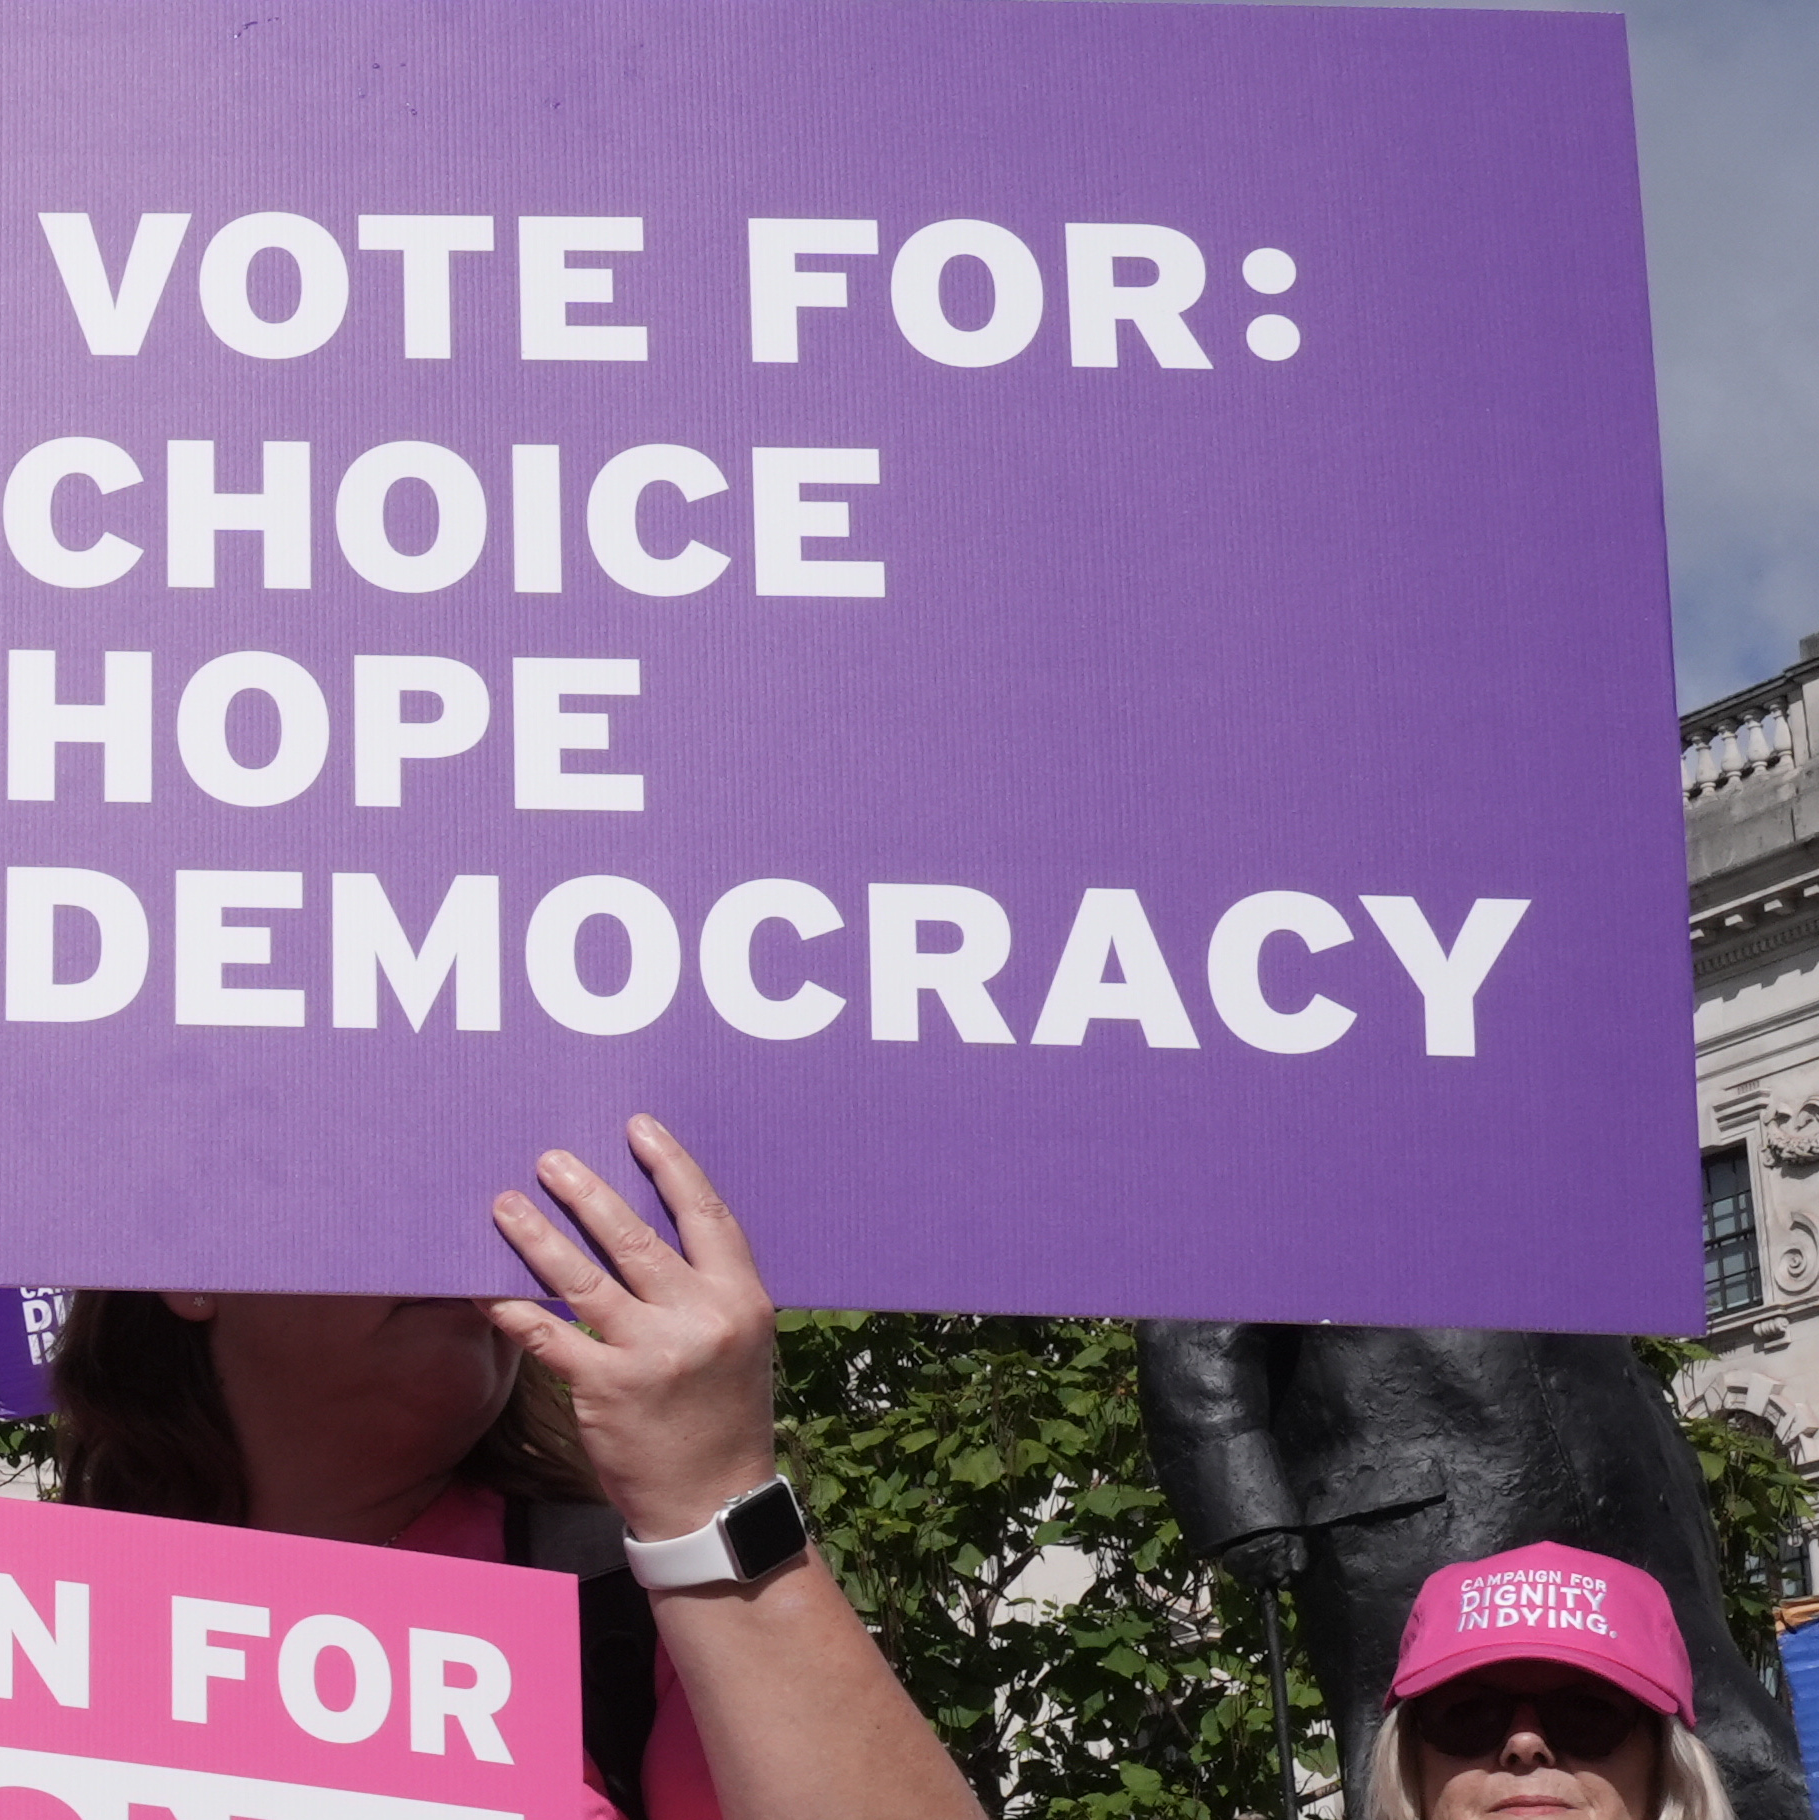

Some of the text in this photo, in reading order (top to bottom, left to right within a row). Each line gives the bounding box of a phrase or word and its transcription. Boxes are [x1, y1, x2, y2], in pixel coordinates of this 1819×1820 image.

[39, 212, 1301, 370] VOTE FOR:
[1, 436, 886, 598] CHOICE
[7, 648, 645, 811] HOPE
[5, 865, 1532, 1057] DEMOCRACY
[1457, 1607, 1618, 1639] IN DYING.
[1460, 1584, 1606, 1613] DIGNITY
[1461, 1569, 1607, 1592] CAMPAIGN FOR
[170, 1595, 515, 1764] FOR
